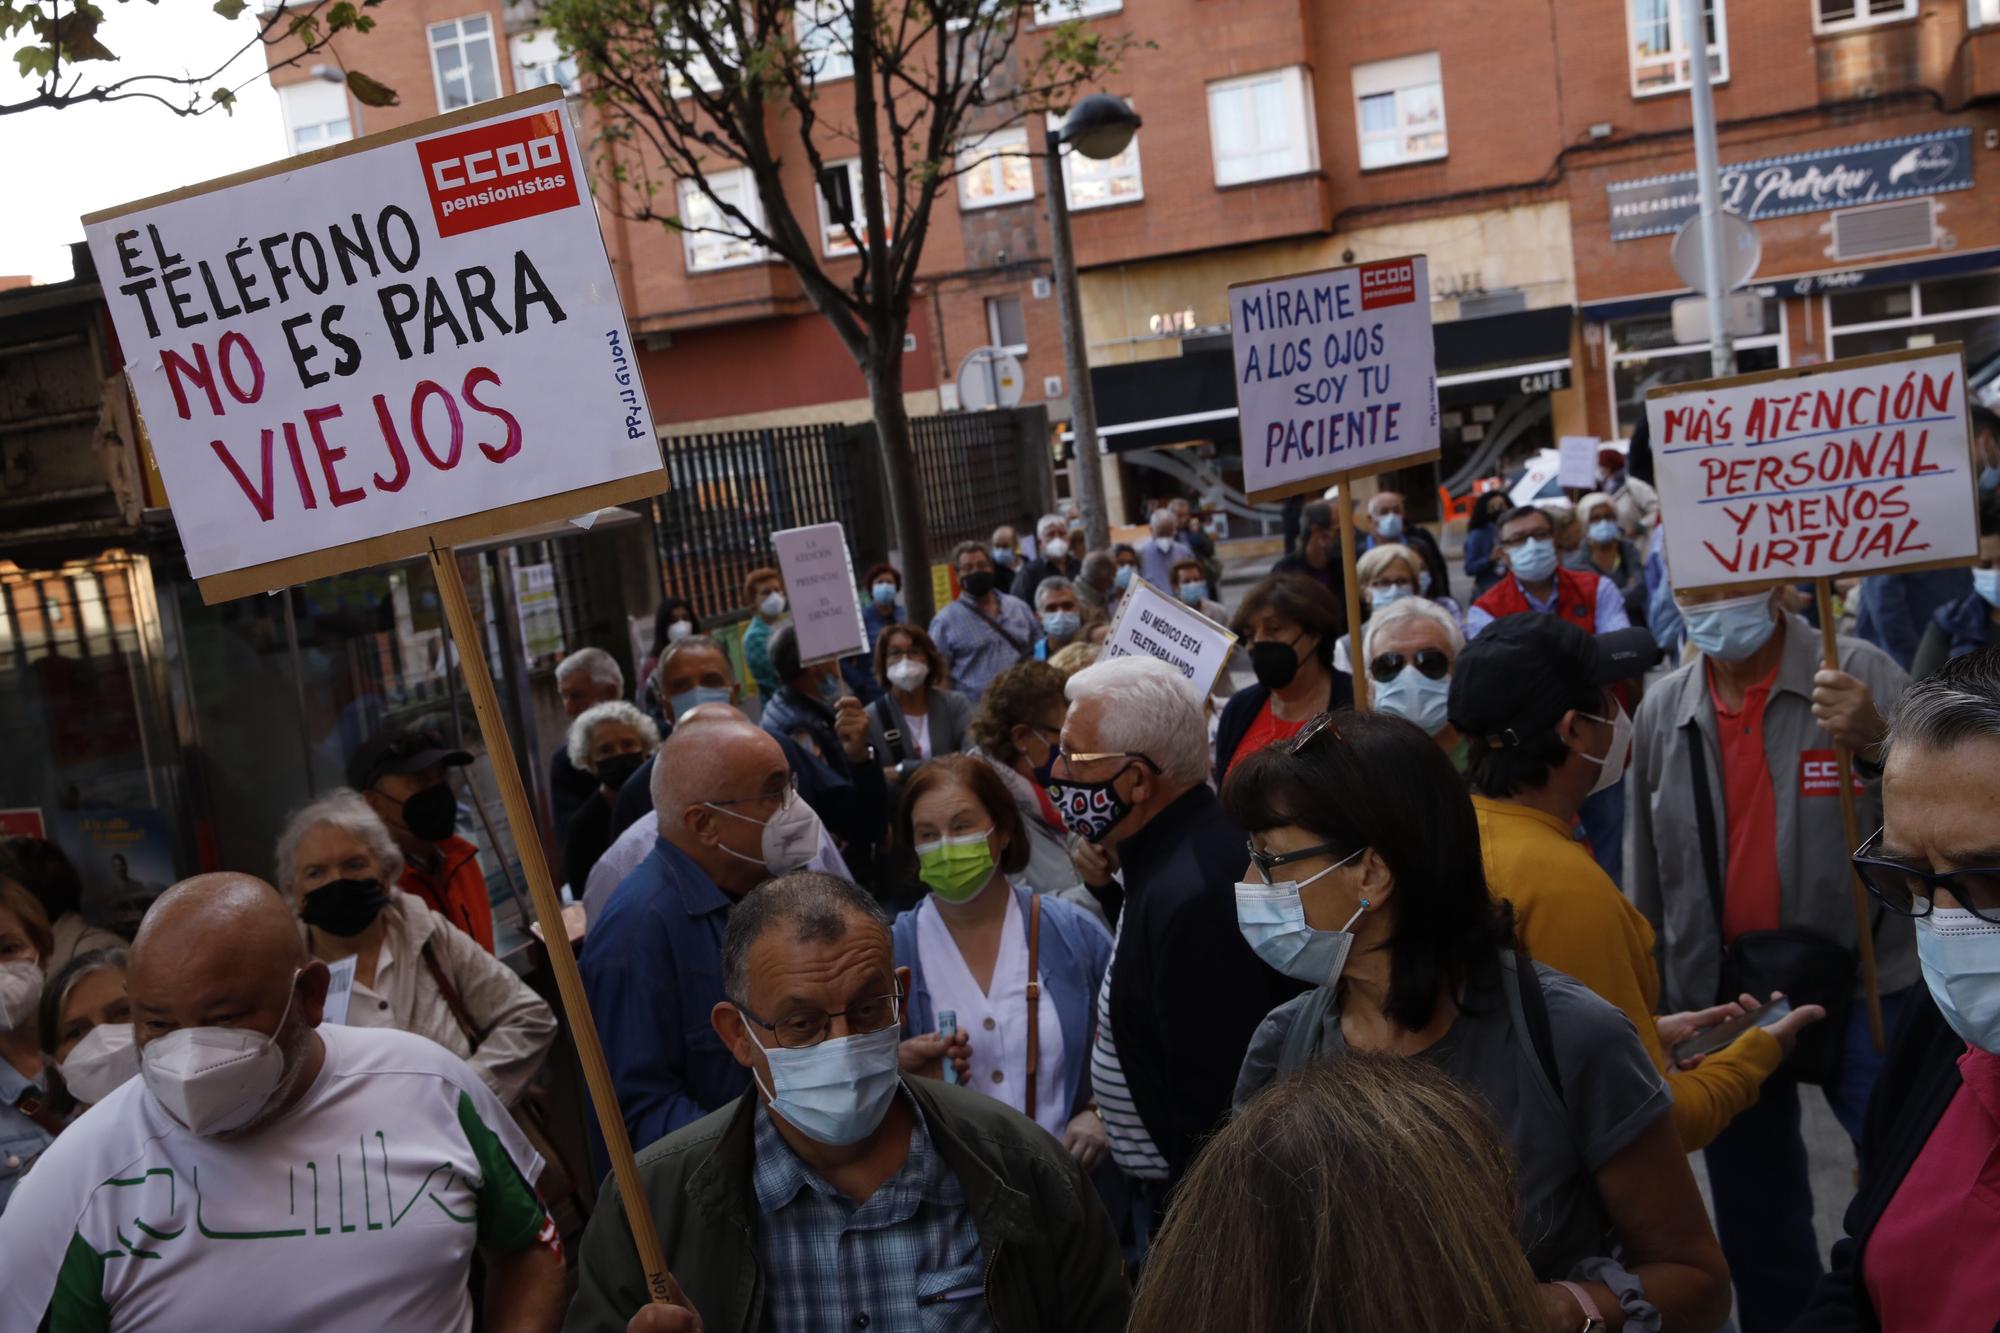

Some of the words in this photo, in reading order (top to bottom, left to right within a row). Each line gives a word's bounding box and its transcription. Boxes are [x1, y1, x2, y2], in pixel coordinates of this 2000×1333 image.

[432, 136, 561, 191] CCOO
[441, 175, 566, 216] pensionistas
[116, 224, 181, 277] EL
[120, 205, 420, 338] TELÉFONO
[1363, 265, 1411, 287] CCOO
[160, 330, 265, 419] NO
[281, 304, 361, 388] ES
[378, 249, 567, 360] PARA
[1242, 284, 1354, 333] MÍRAME
[606, 330, 630, 385] GIJON
[1244, 345, 1262, 384] A
[1268, 338, 1311, 379] LOS
[1325, 323, 1384, 368] OJOS
[1294, 374, 1348, 405] SOY
[1358, 364, 1390, 398] TU
[1745, 370, 1954, 444] ATENCIÓN
[211, 366, 522, 521] VIEJOS
[1266, 402, 1401, 467] PACIENTE
[1700, 430, 1939, 497] PERSONAL
[1722, 503, 1758, 536] Y
[1767, 485, 1910, 535] MENOS
[1703, 518, 1931, 573] VIRTUAL
[1140, 609, 1153, 624] SU
[1152, 616, 1181, 643] MÉDICO
[1180, 634, 1203, 656] ESTÁ
